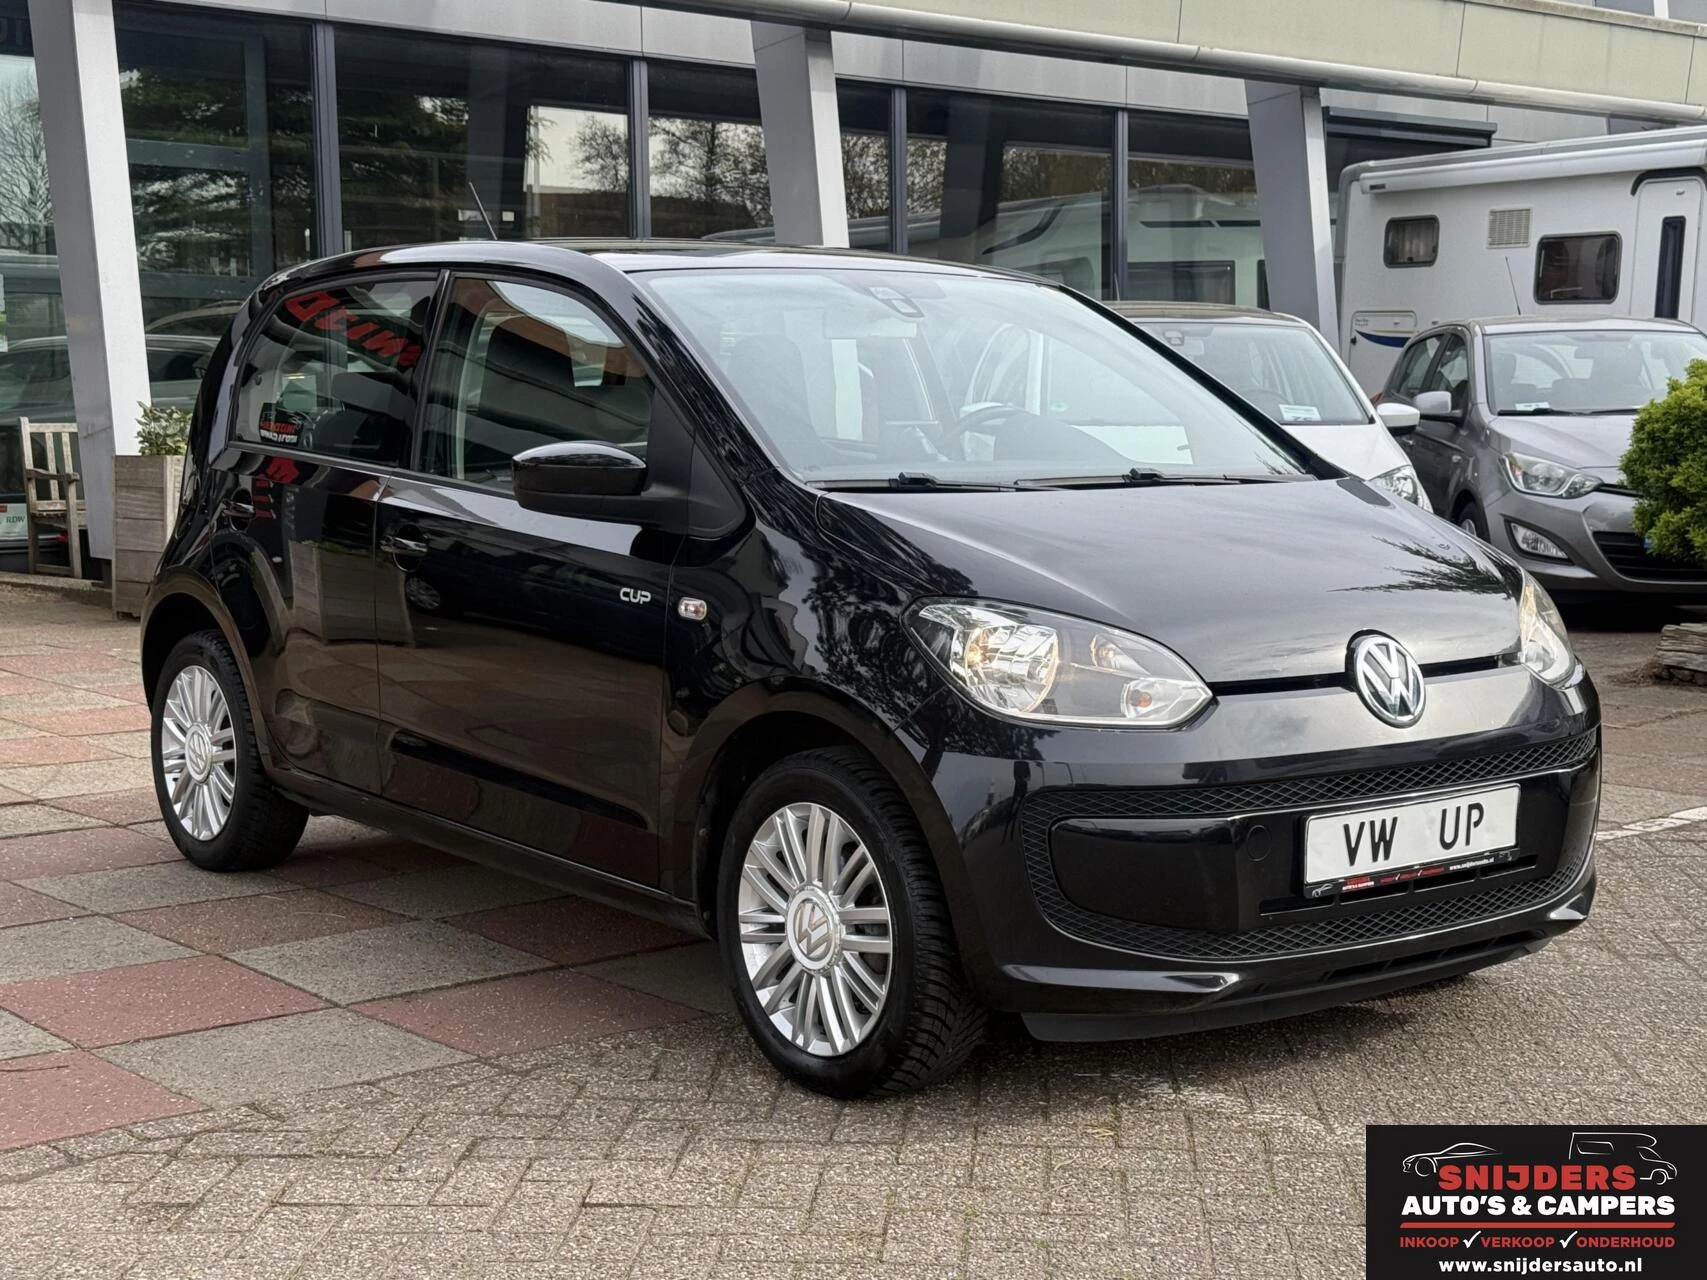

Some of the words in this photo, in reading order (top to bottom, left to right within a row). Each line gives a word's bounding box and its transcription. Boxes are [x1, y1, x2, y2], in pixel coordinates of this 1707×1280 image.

[620, 587, 651, 604] CUP
[1356, 636, 1426, 724] VW
[1343, 816, 1399, 867] VW
[1439, 802, 1485, 851] UP
[790, 894, 834, 966] VW
